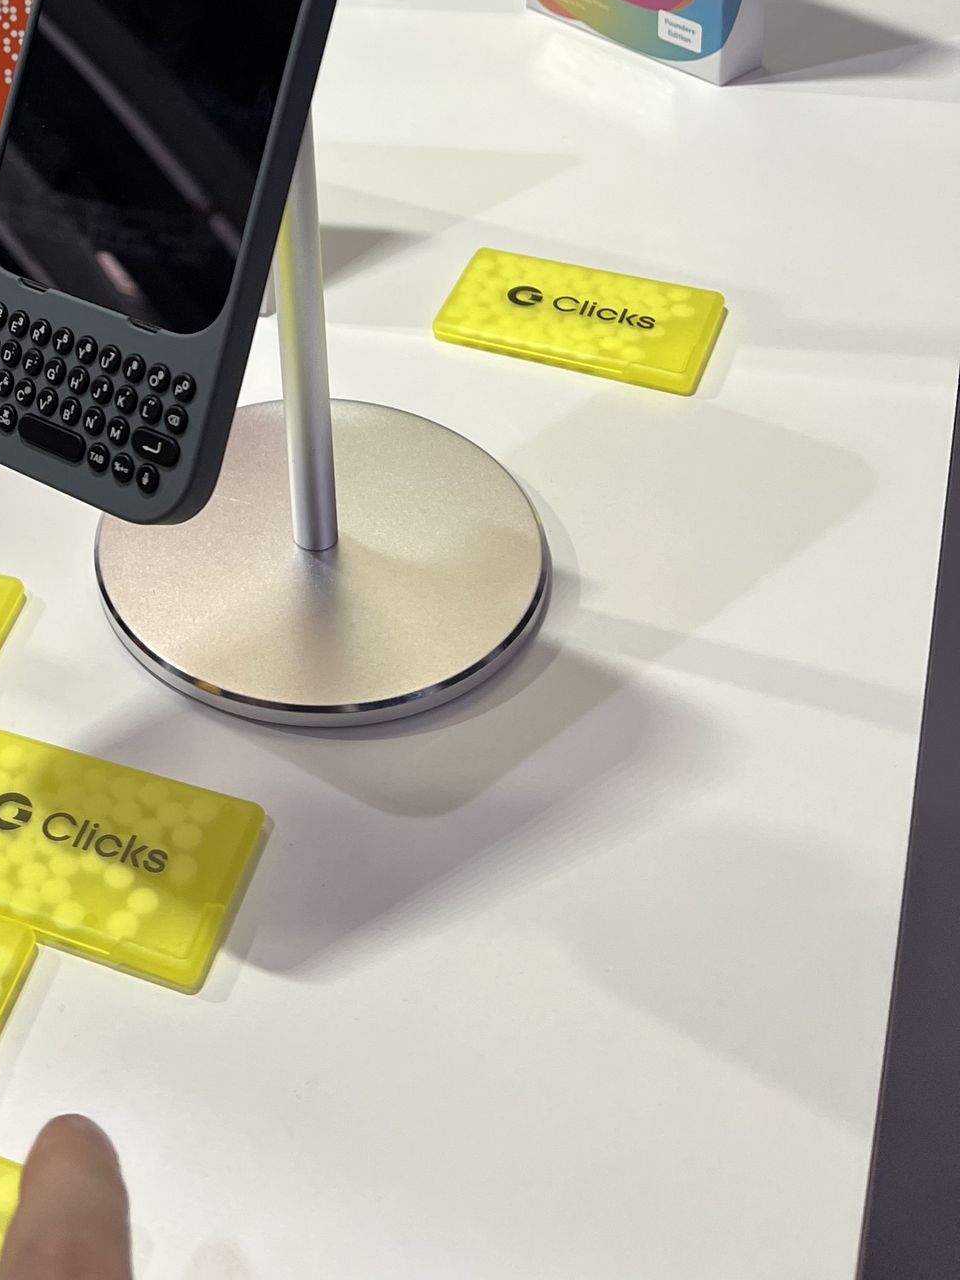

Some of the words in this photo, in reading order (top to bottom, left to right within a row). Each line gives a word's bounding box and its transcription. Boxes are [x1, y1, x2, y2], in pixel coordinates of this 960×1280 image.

[553, 296, 656, 329] Clicks
[90, 451, 104, 464] TAB
[42, 811, 169, 875] Clicks
